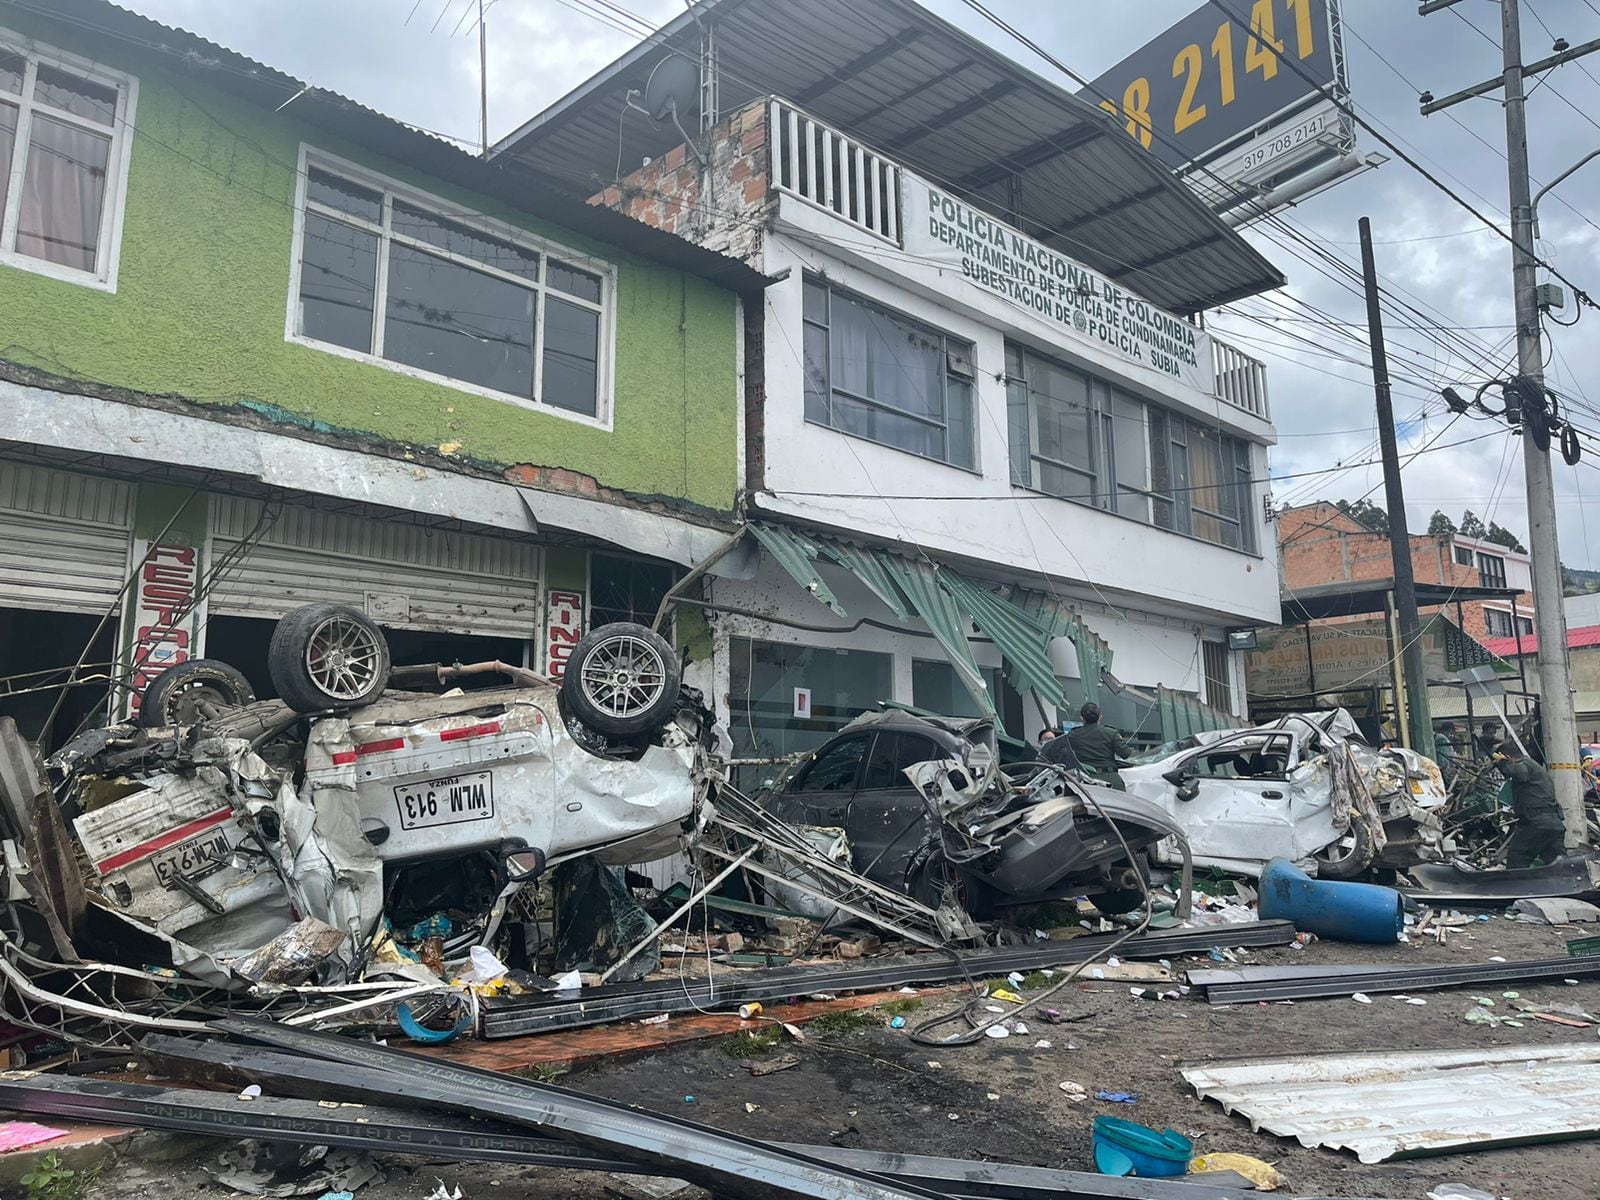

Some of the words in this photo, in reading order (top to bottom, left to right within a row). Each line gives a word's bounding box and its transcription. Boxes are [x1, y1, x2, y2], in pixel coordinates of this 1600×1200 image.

[1171, 0, 1314, 134] 2141
[1244, 149, 1264, 170] 319
[1268, 135, 1291, 157] 708
[1295, 117, 1323, 143] 2141
[928, 189, 1007, 252] POLICIA
[1012, 234, 1099, 297] NACIONAL
[1104, 284, 1122, 309] DE
[1126, 297, 1196, 347] COLOMBIA
[929, 216, 1036, 287] DEPARTAMENTO
[1039, 277, 1055, 297] DE
[1058, 284, 1103, 322] POLICIA
[1106, 307, 1120, 328] DE
[1122, 316, 1198, 369] CUNDINAMARCA
[961, 257, 1052, 317] SUBESTACION
[1056, 303, 1071, 326] DE
[1089, 321, 1142, 360] POLICIA
[1151, 352, 1181, 378] SUBIA
[429, 777, 459, 788] FUNZA
[450, 784, 486, 812] WLM
[405, 791, 437, 819] 913
[144, 1103, 248, 1127] COLMENA
[459, 1136, 598, 1158] ORRUGADO
